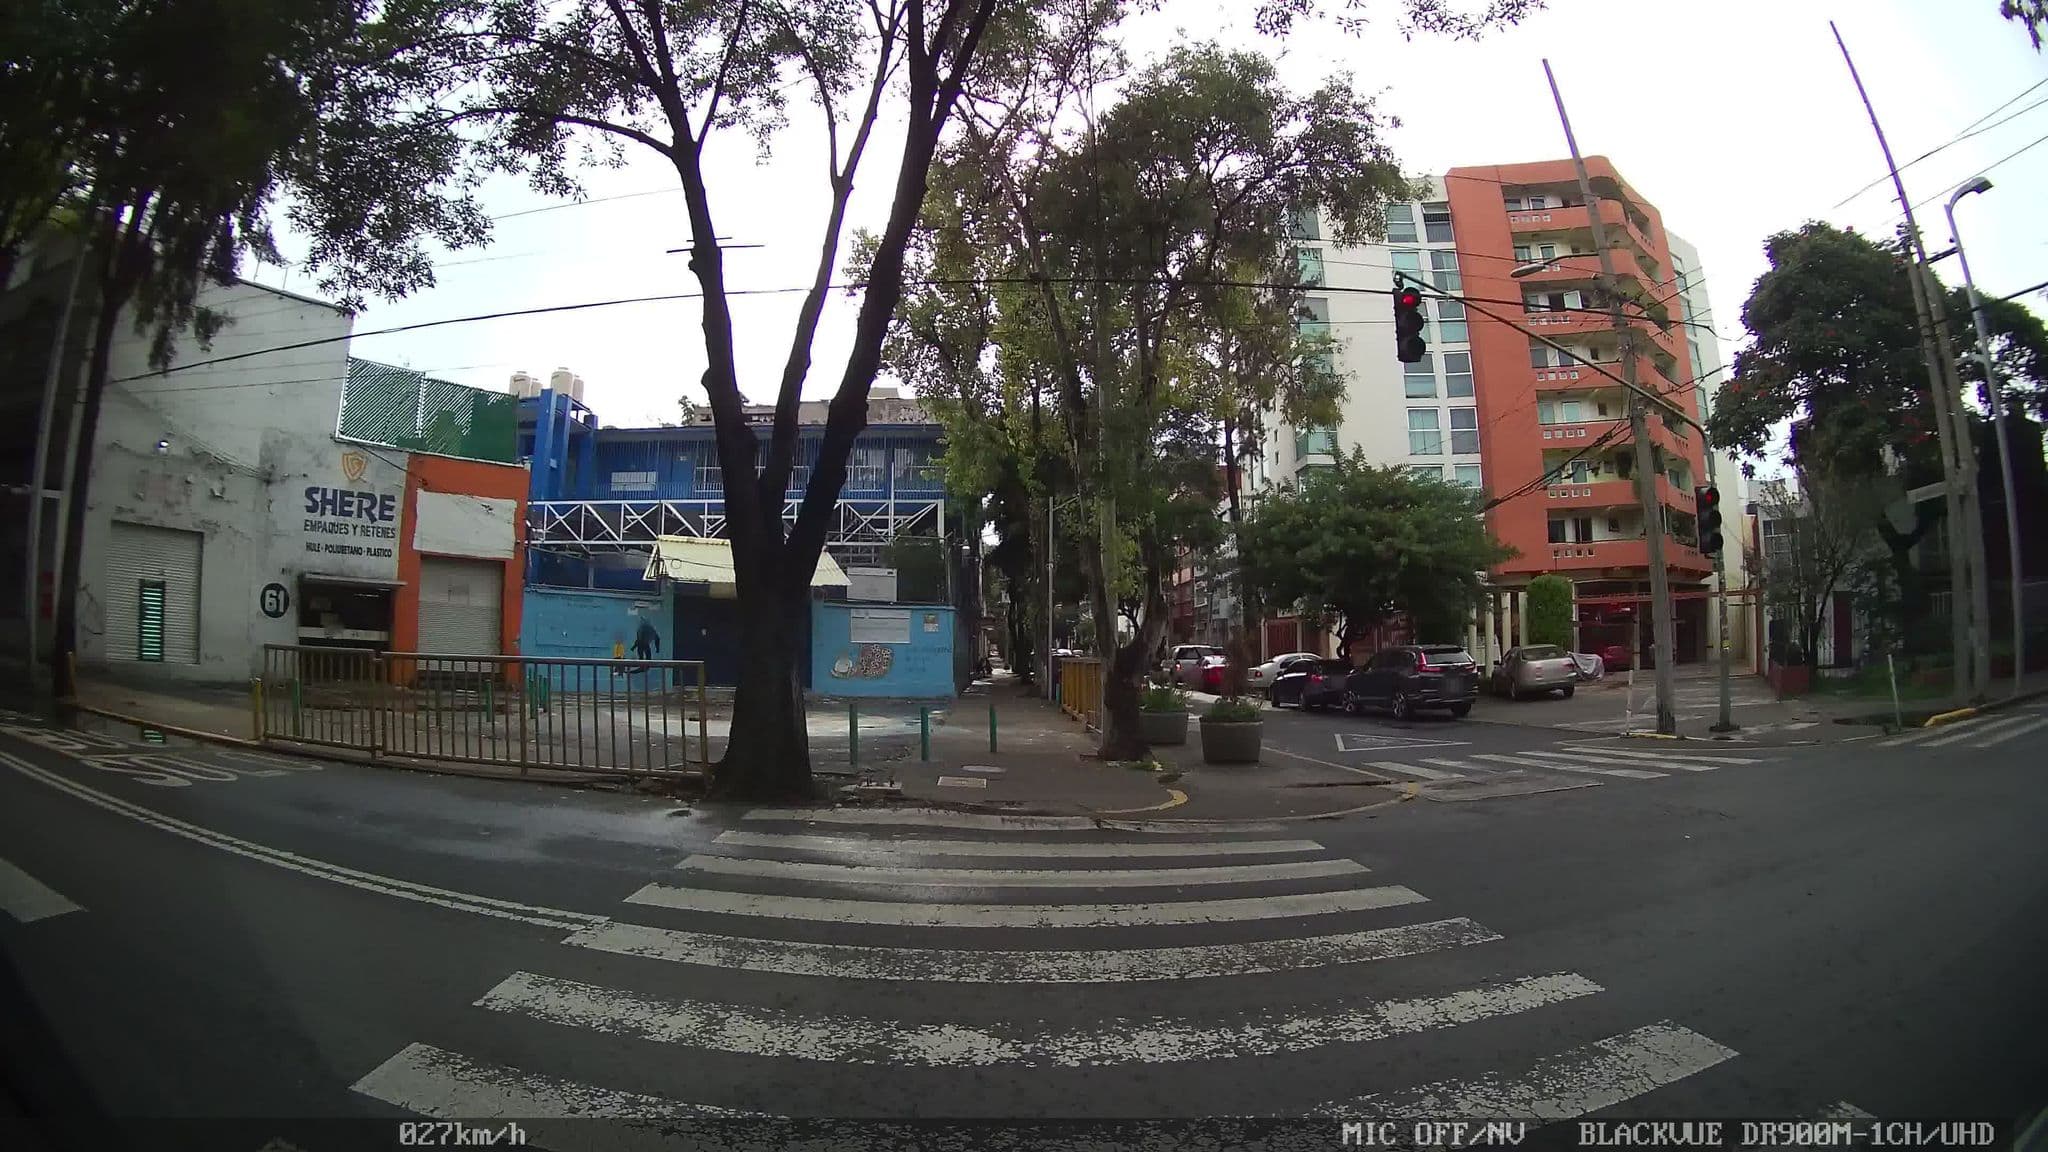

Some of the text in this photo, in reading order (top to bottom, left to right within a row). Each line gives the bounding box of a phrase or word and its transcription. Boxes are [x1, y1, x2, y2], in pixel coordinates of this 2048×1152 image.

[304, 486, 396, 524] SHERE
[304, 519, 396, 539] EMPAQUES Y RETENES
[306, 542, 321, 553] HULE
[366, 547, 393, 558] PLASTICO
[265, 589, 285, 613] 61
